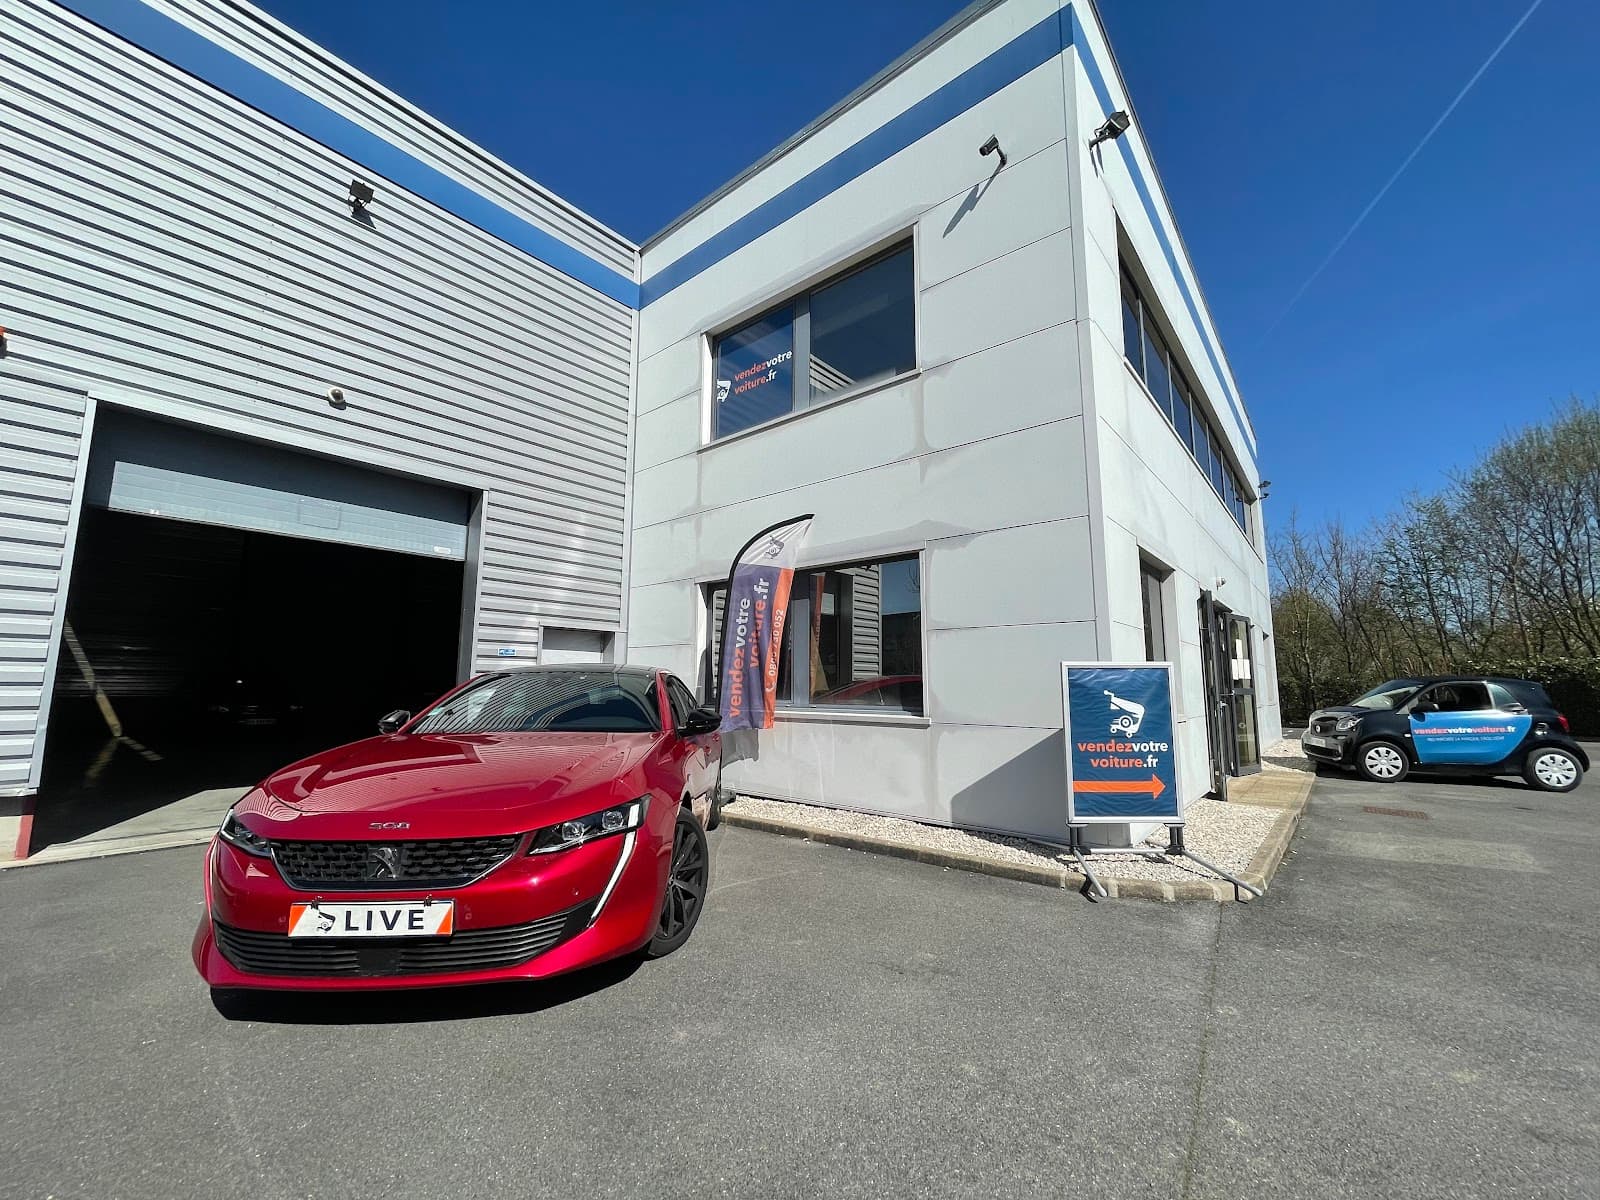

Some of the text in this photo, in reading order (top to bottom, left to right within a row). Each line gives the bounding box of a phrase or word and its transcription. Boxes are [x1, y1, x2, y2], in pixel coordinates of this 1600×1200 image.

[734, 350, 793, 382] vendezvotre
[734, 369, 777, 394] voiture.fr
[749, 578, 771, 669] voiture.fr
[774, 609, 784, 628] 052
[729, 598, 751, 718] vendezvotre
[1414, 725, 1517, 735] vendezvotrevoiture.fr
[1077, 739, 1169, 752] vendezvotre
[1090, 754, 1159, 768] voiture.fr
[345, 909, 425, 931] LIVE
